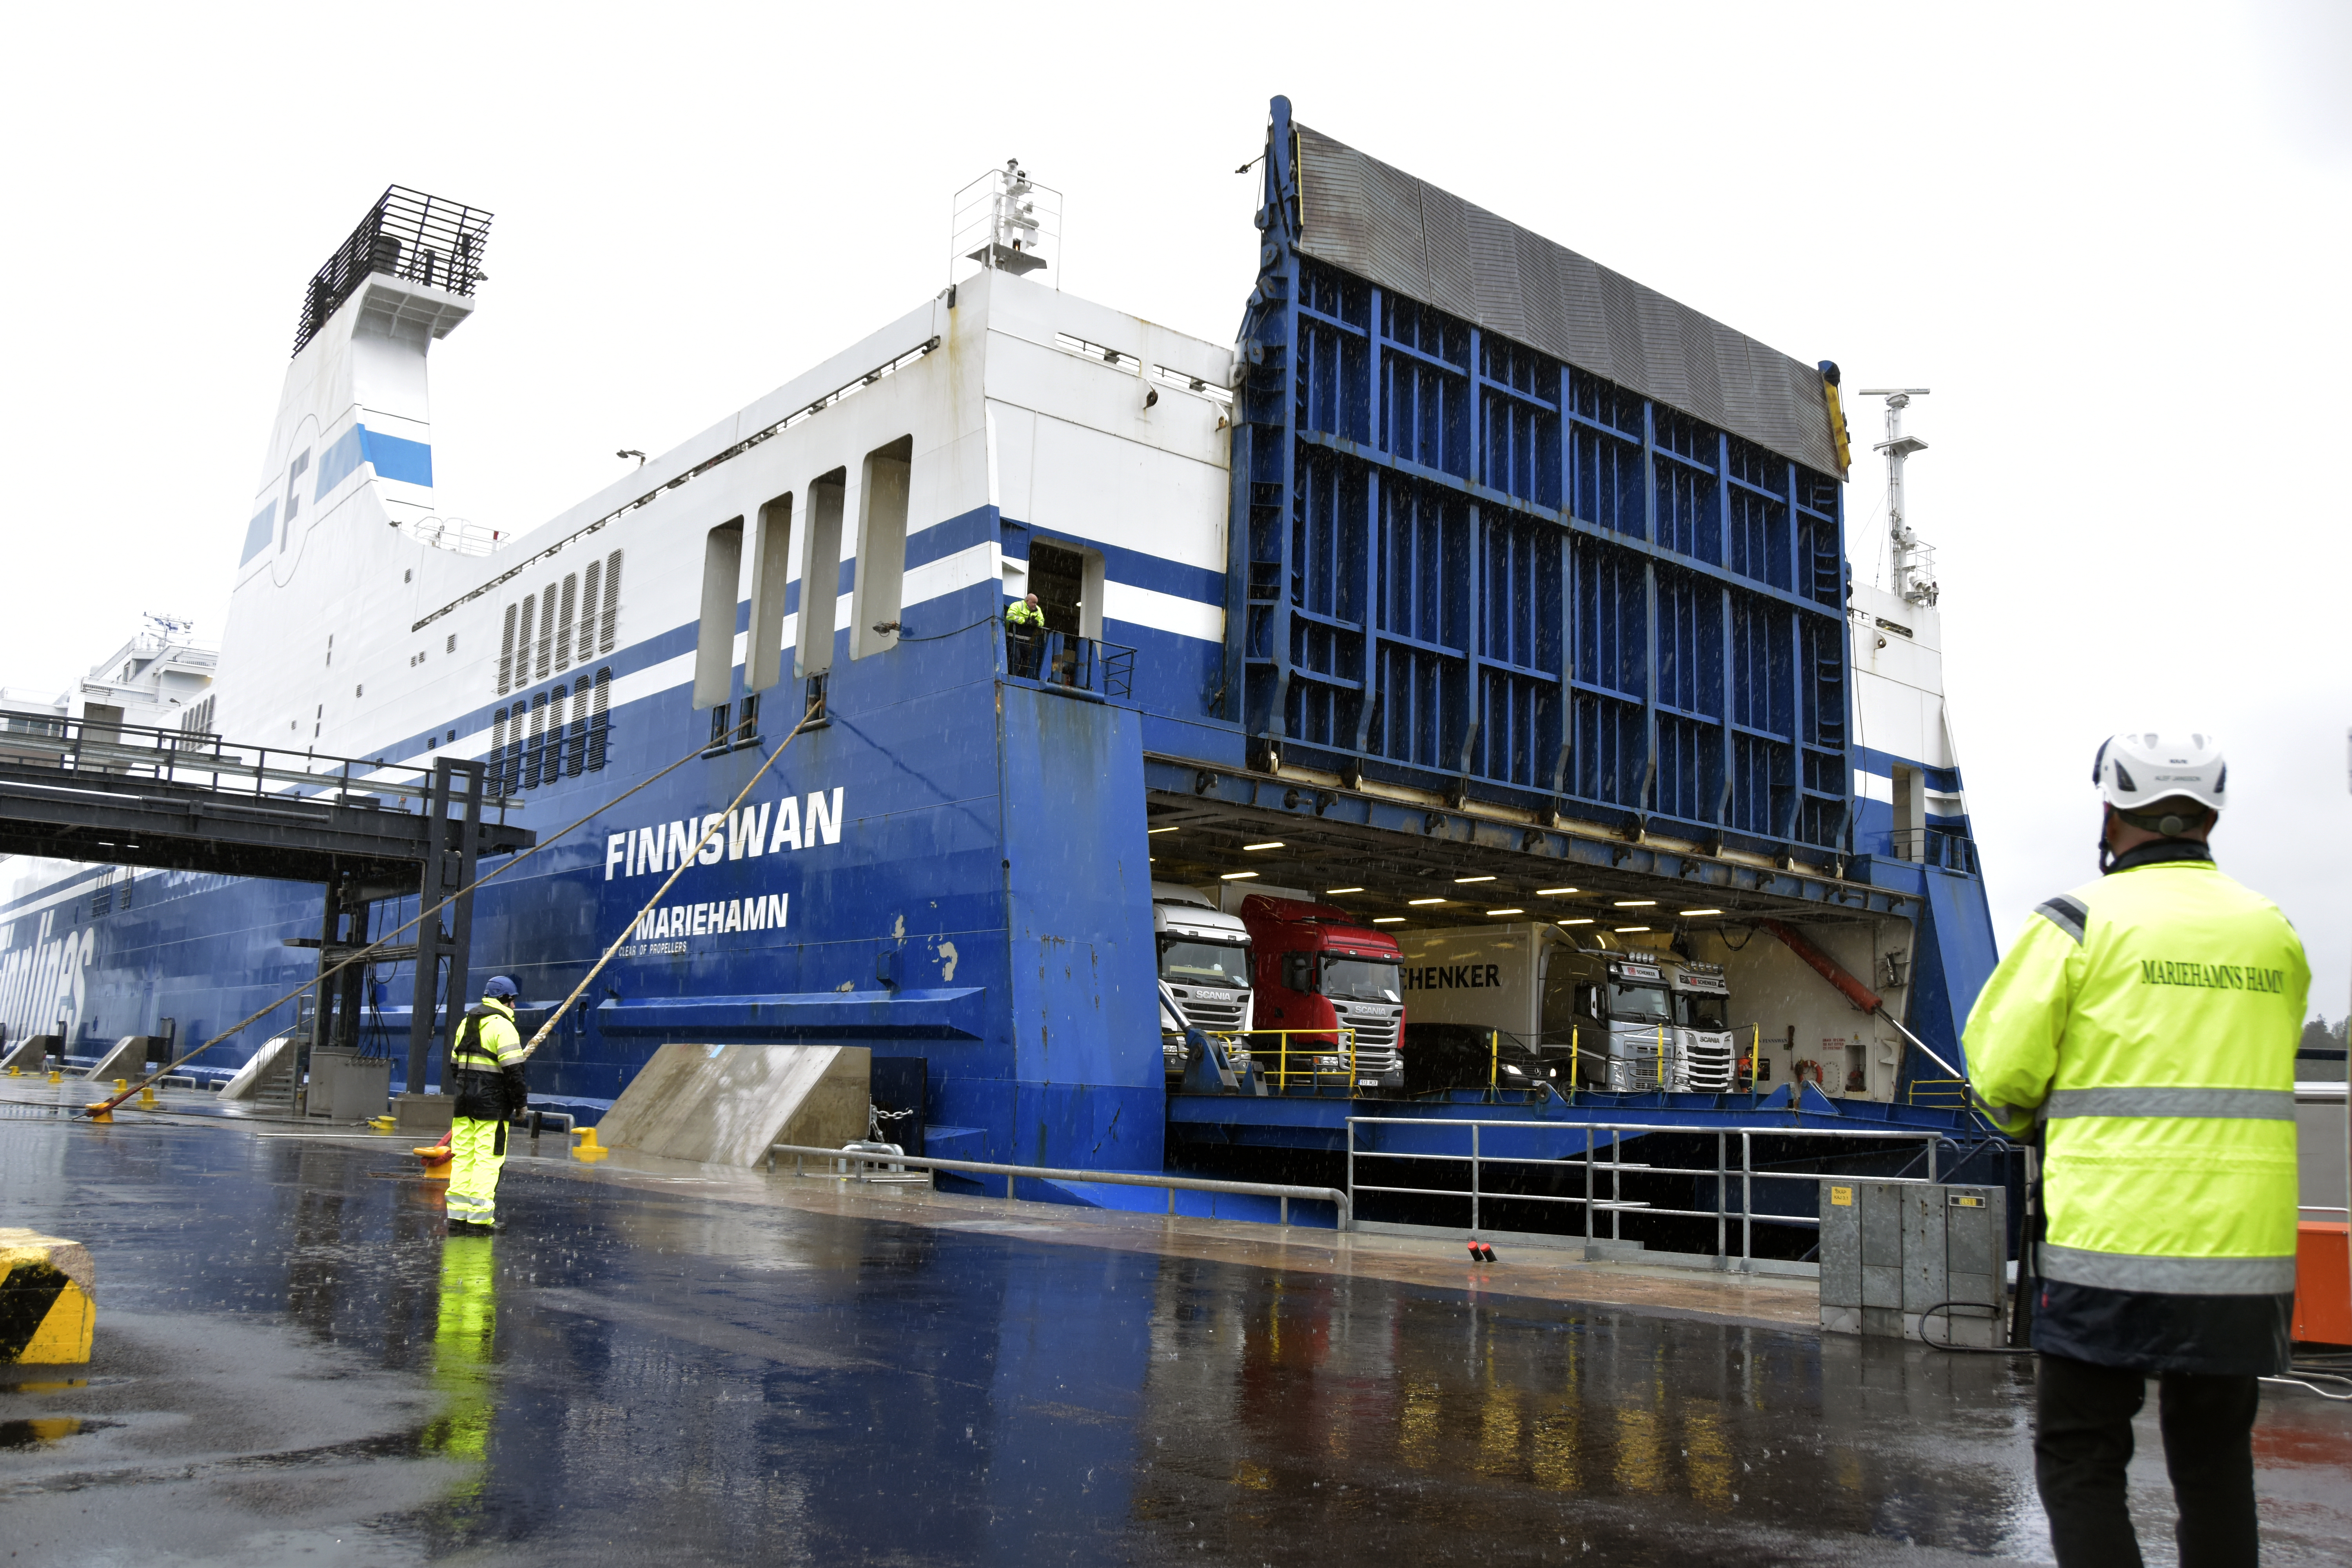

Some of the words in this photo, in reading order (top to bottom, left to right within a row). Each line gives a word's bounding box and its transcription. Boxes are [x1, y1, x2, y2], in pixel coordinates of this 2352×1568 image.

[280, 446, 311, 554] F
[605, 787, 844, 881] FINNSWAN
[635, 893, 788, 940] MARIEHAMN
[619, 946, 636, 957] CLEAR
[639, 944, 647, 955] OF
[650, 941, 686, 955] PROPELLERS
[1402, 964, 1500, 990] HENKER
[2141, 960, 2243, 989] MARIEHAMNS
[1196, 990, 1231, 1001] SCANIA
[1355, 1006, 1386, 1015] SCANIA
